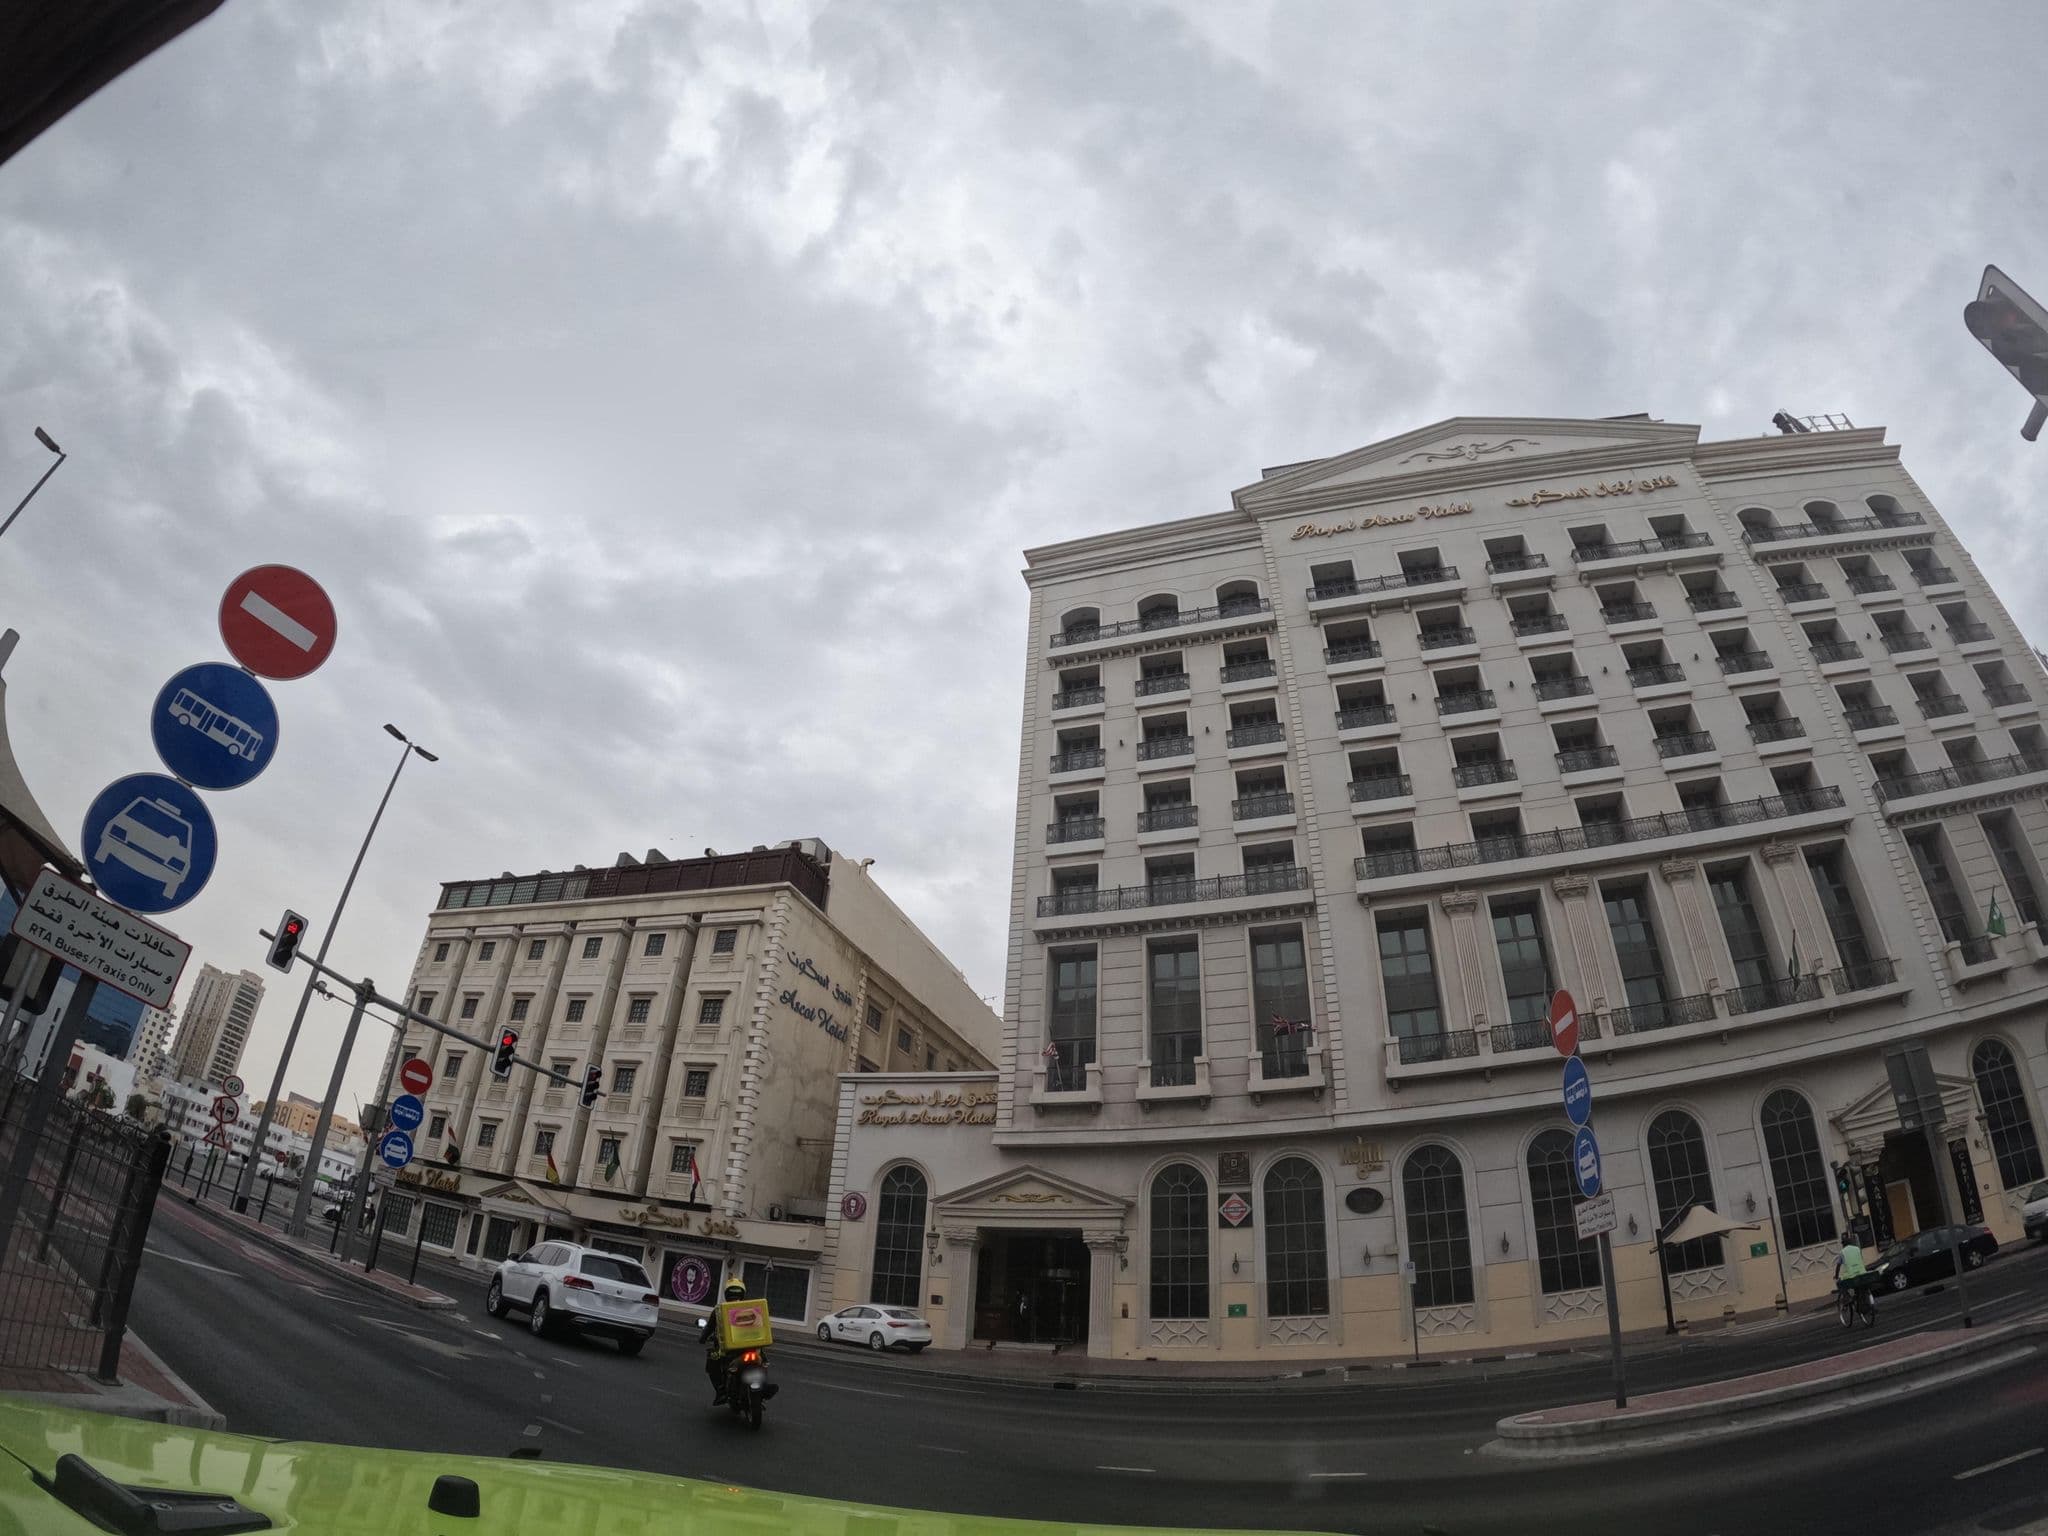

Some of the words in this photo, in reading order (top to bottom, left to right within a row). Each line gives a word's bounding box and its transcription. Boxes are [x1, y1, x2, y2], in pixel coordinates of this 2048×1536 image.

[1290, 520, 1357, 541] Royal
[1360, 512, 1416, 530] Ascot
[1417, 500, 1473, 520] Hotel
[42, 882, 90, 913] الطرق
[29, 899, 63, 925] فقط
[91, 905, 121, 931] هيئة
[124, 927, 176, 958] حافلات
[28, 922, 52, 944] RTA
[128, 975, 156, 997] Only
[114, 946, 164, 978] سيارات
[779, 989, 816, 1022] Ascot
[817, 1008, 849, 1044] Hotel
[227, 1081, 240, 1092] 40
[858, 1109, 907, 1128] Royal
[906, 1109, 952, 1125] Ascot
[425, 1169, 461, 1193] Hotel
[697, 1216, 741, 1239] فندق
